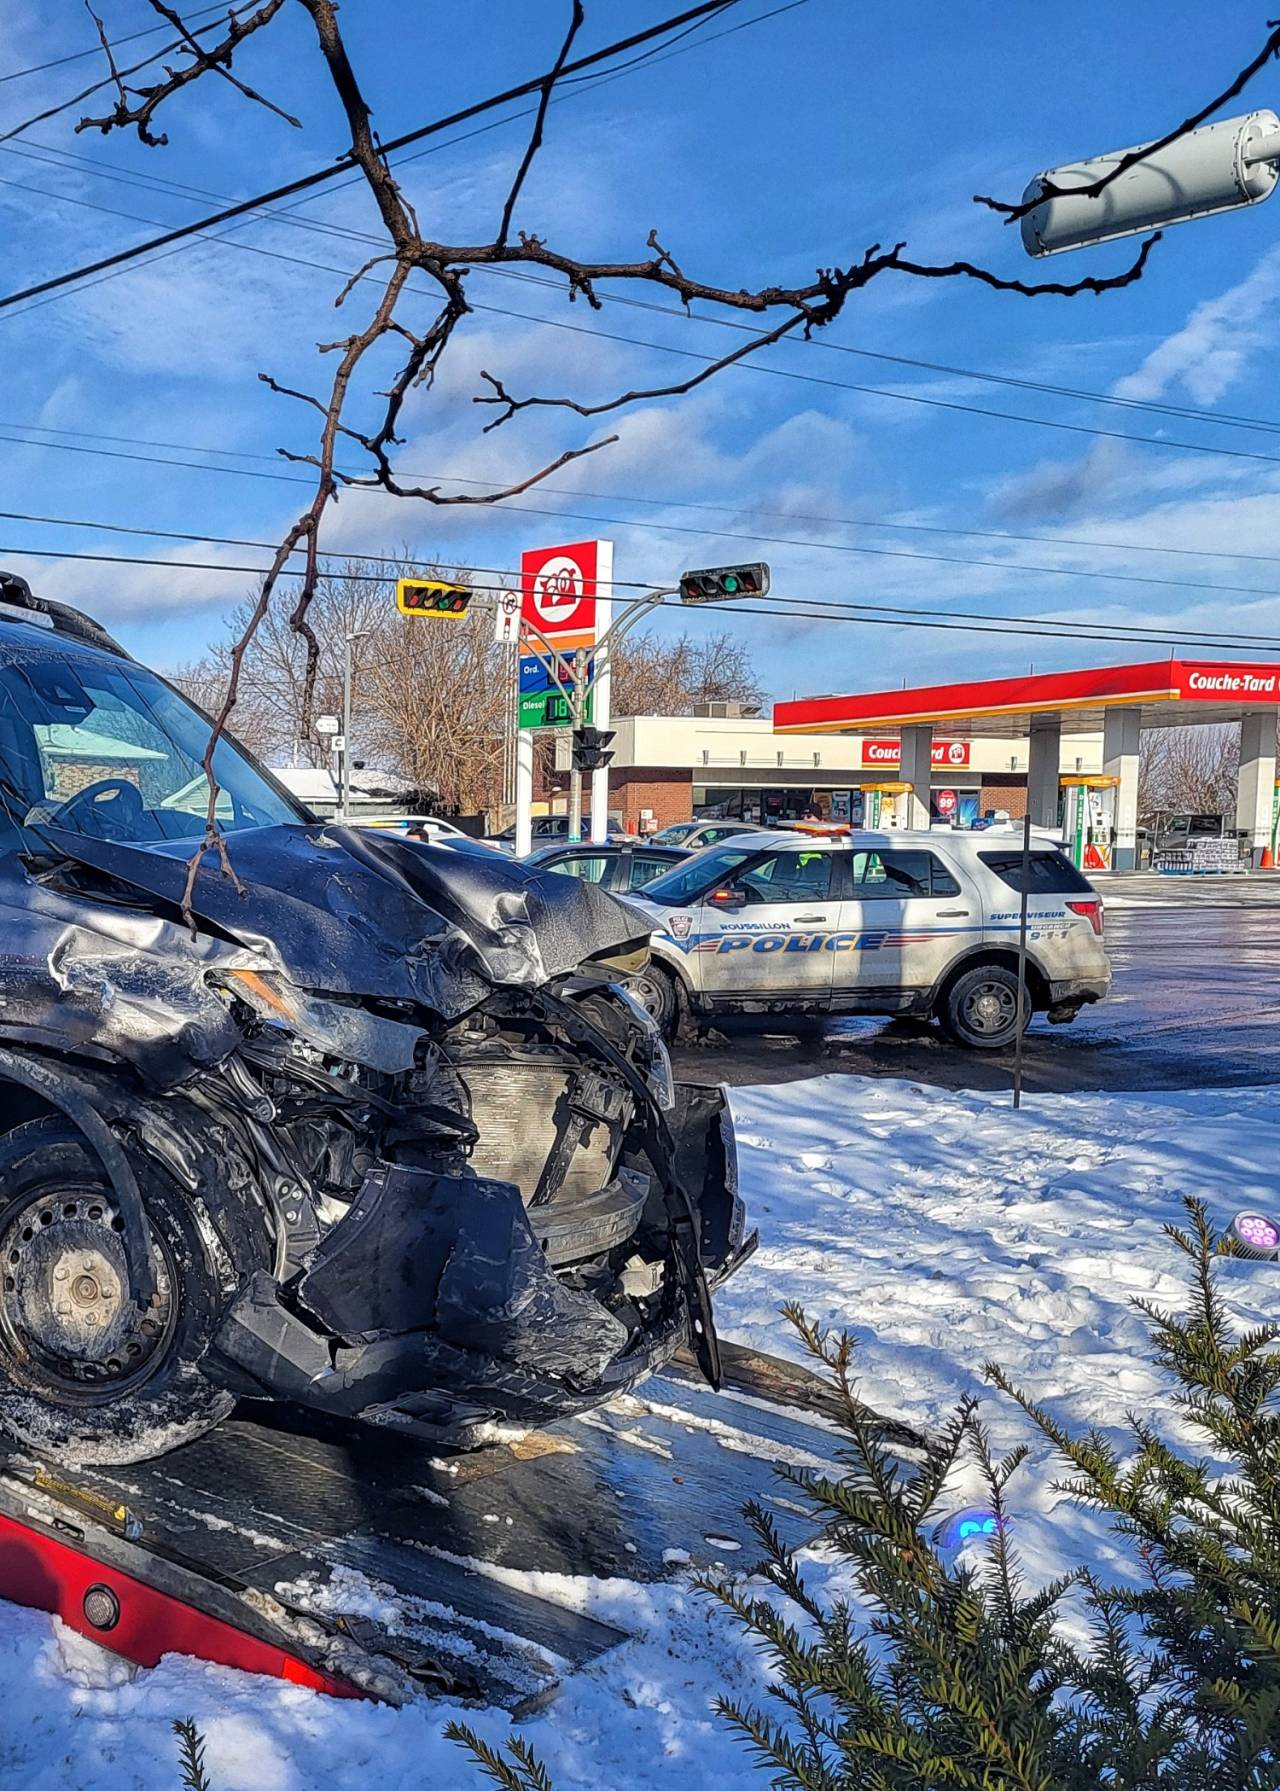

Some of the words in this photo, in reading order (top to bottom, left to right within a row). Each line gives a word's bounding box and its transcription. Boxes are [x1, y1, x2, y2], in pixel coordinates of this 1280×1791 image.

[523, 665, 540, 674] Ord.
[1188, 672, 1276, 692] Couche-Tard
[522, 700, 545, 710] Diesel
[990, 911, 1066, 920] SUPEVISEUR
[721, 922, 791, 931] ROUSSILLON
[1030, 930, 1068, 940] 9-1-1
[717, 933, 888, 954] POLICE
